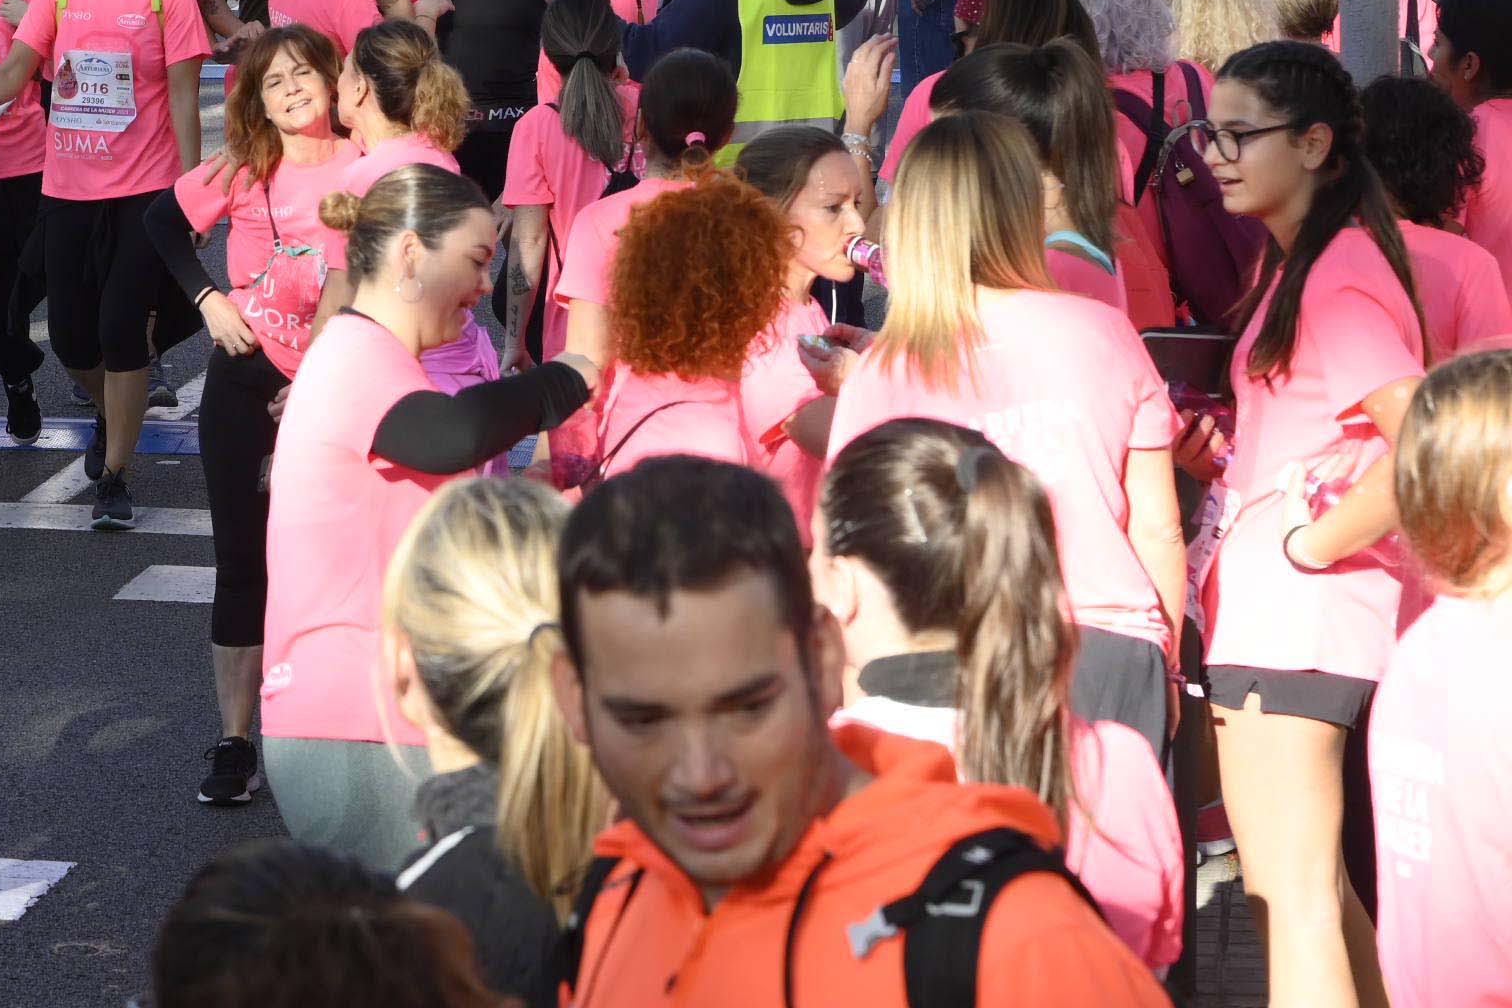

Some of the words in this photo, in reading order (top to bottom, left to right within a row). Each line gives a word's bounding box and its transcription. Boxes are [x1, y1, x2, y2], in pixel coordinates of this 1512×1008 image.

[765, 15, 828, 37] VOLUNTARIS
[81, 82, 109, 95] 016
[82, 96, 105, 105] 29396
[489, 107, 524, 121] MAX
[54, 133, 110, 154] SUMA
